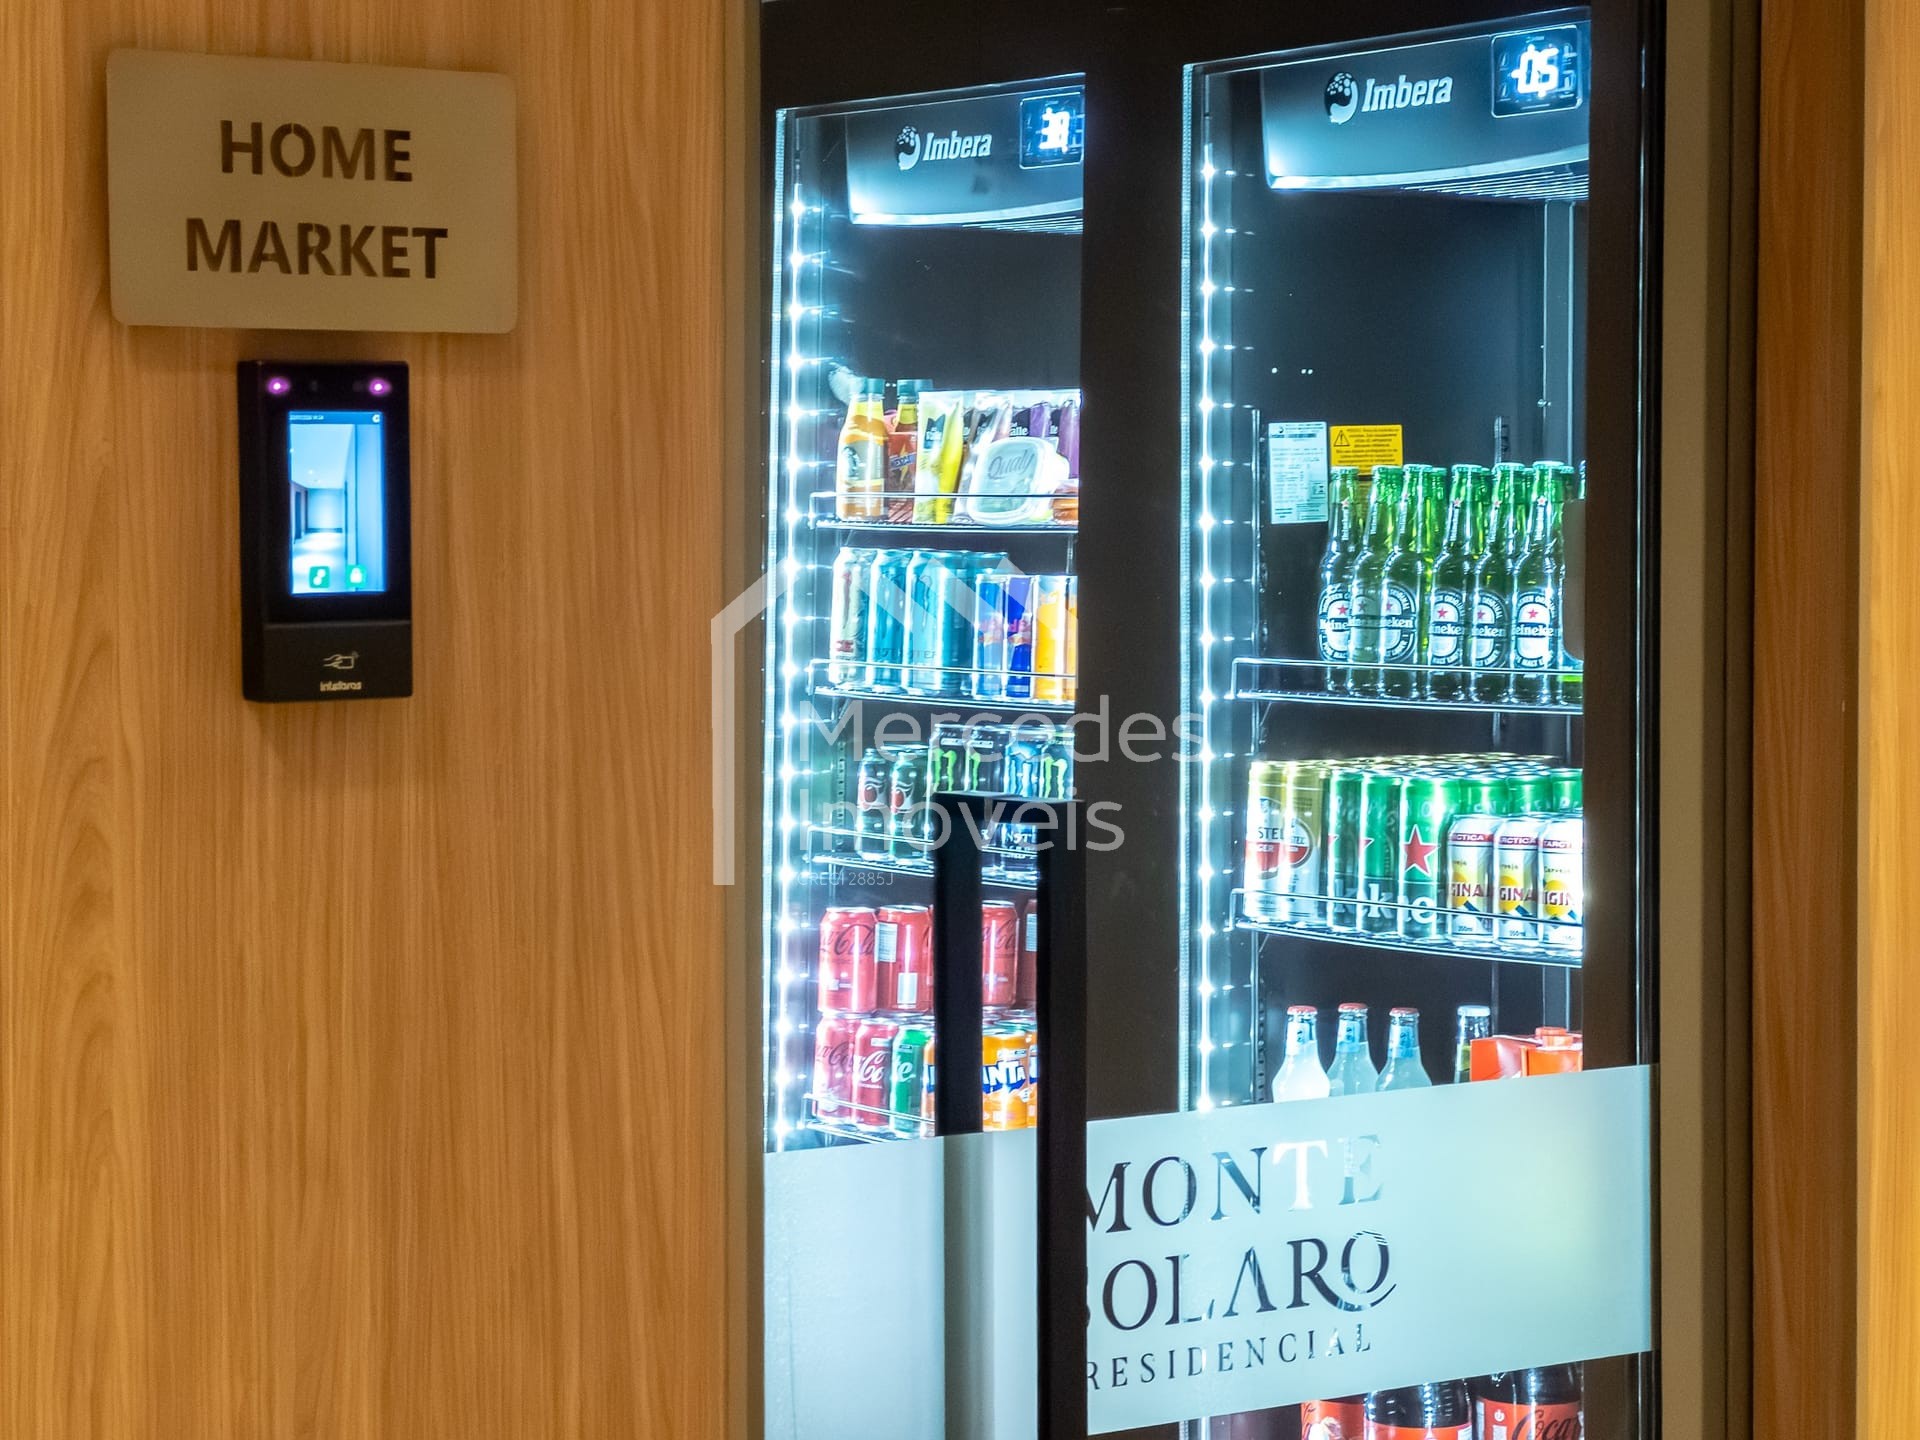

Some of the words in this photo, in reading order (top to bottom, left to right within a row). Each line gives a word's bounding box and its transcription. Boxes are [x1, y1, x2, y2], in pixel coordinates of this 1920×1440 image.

[1361, 74, 1453, 112] Imbera
[219, 119, 413, 182] HOME
[922, 130, 992, 161] Imbera
[185, 217, 449, 279] MARKET
[1087, 1134, 1383, 1234] MONTE
[1088, 1230, 1397, 1332] OLARO
[1088, 1322, 1371, 1391] RESIDENCIAL
